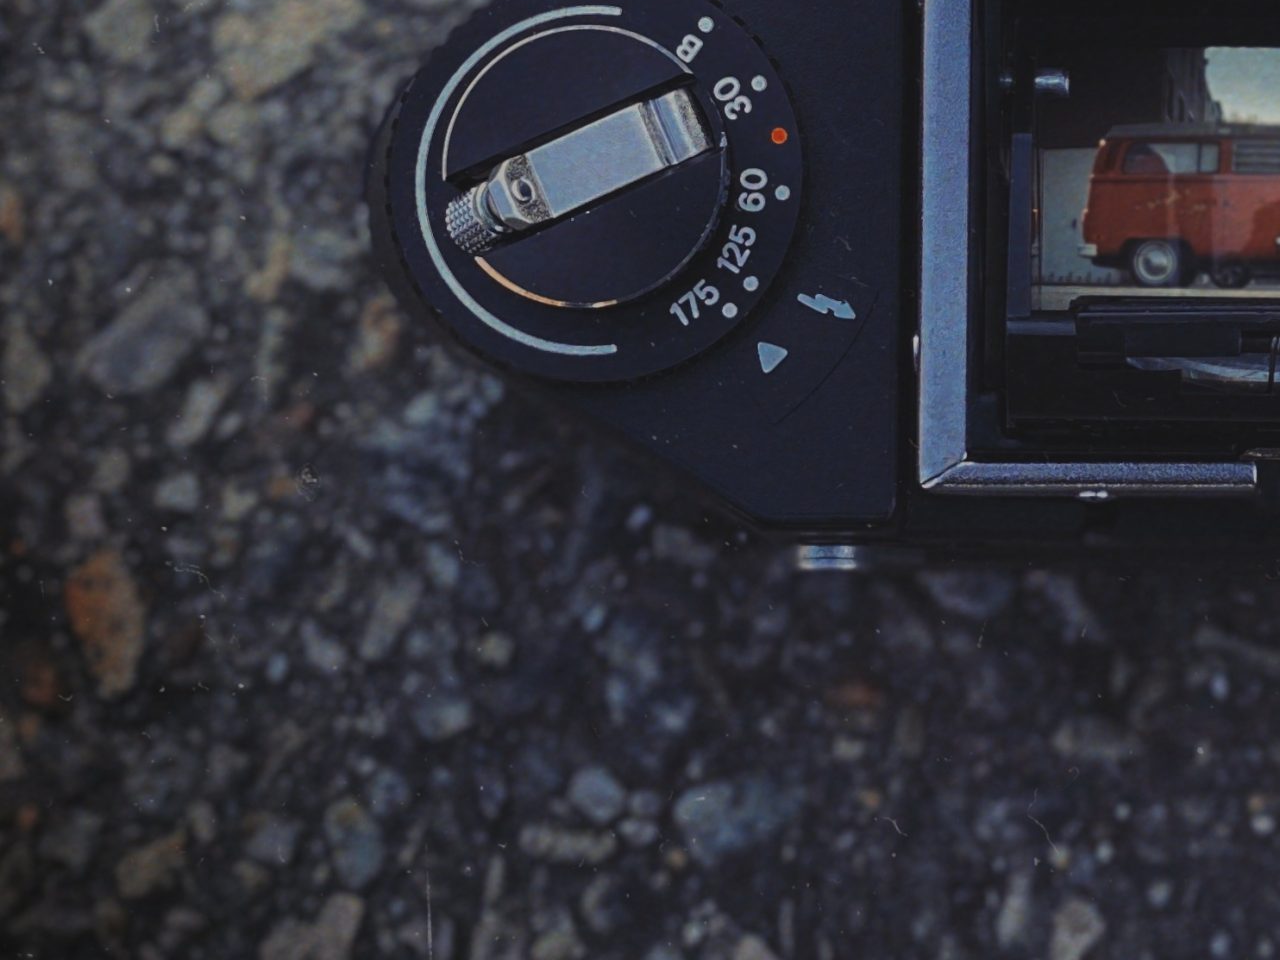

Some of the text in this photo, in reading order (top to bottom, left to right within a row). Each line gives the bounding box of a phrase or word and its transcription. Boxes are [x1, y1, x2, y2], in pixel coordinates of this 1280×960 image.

[675, 33, 703, 64] B
[712, 76, 752, 121] 30
[737, 167, 768, 213] 60
[716, 224, 757, 275] 125
[669, 278, 720, 326] 175
